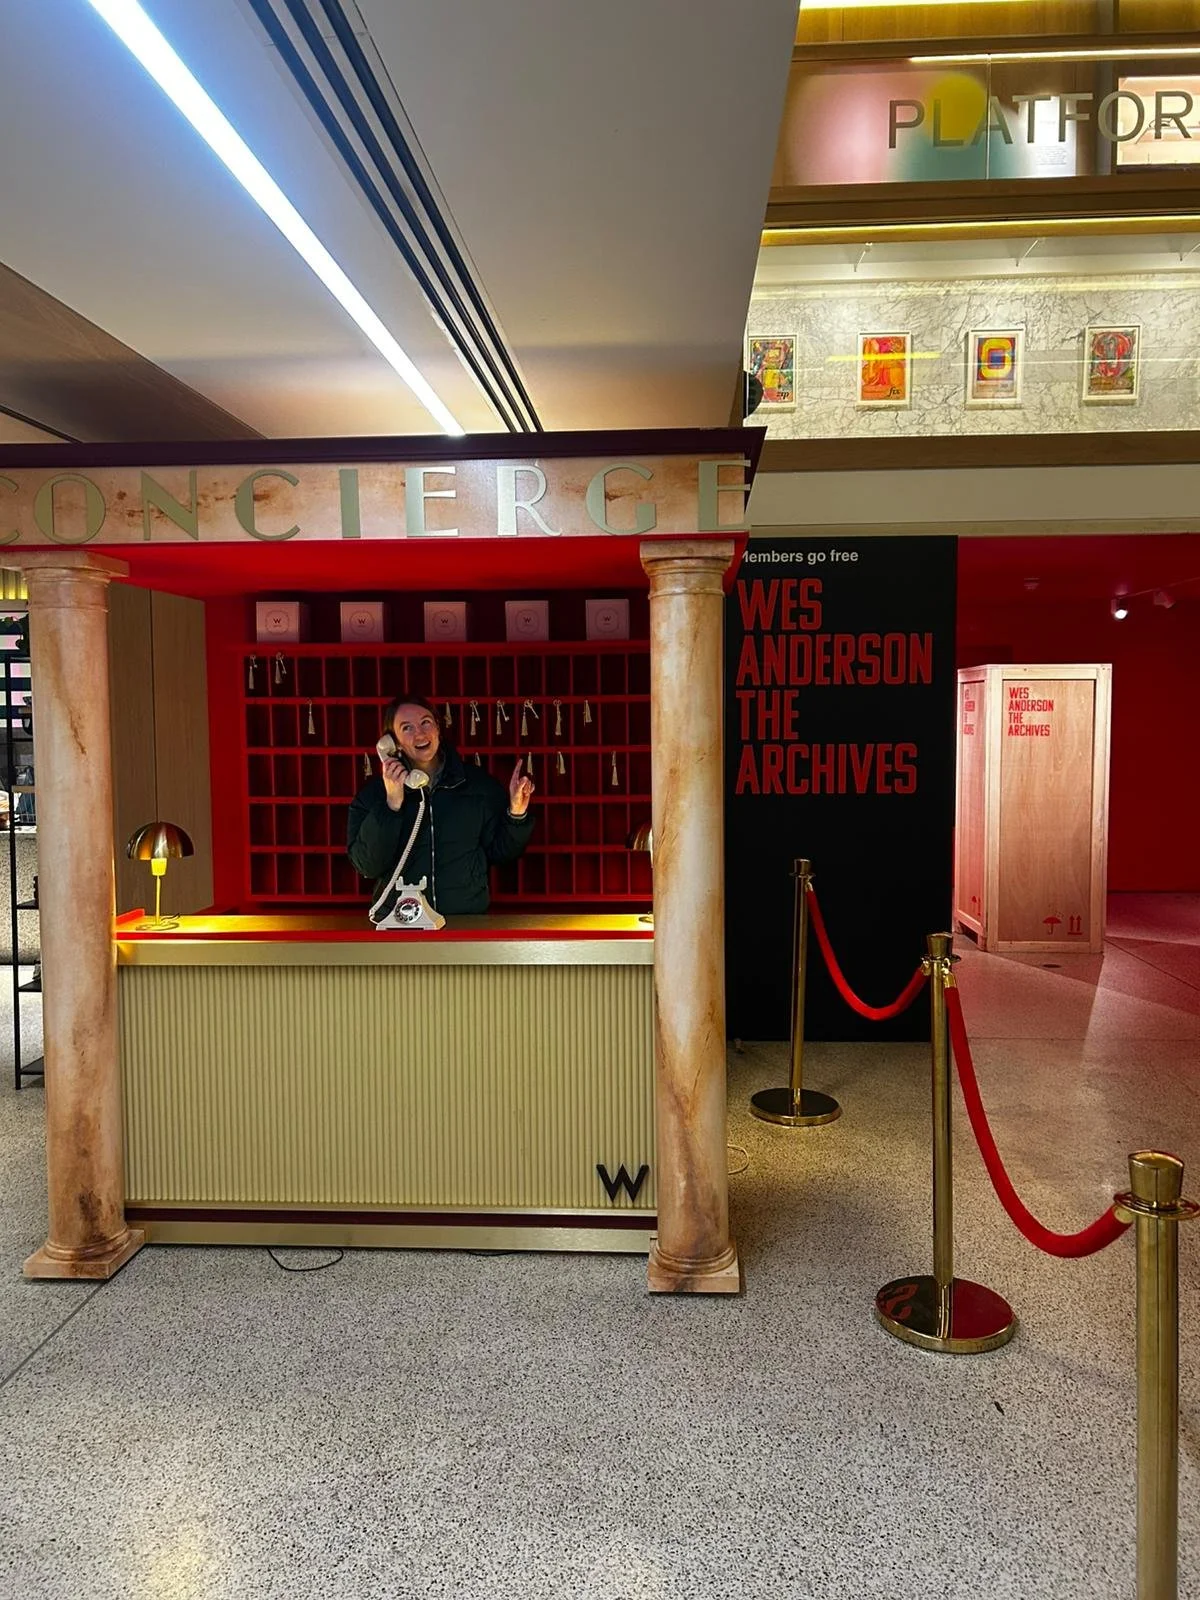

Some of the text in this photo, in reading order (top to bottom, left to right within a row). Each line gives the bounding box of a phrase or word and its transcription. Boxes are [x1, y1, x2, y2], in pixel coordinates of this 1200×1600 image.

[888, 90, 1193, 149] PLATFOR
[807, 552, 826, 565] go
[830, 549, 859, 562] free
[737, 578, 823, 630] WES
[736, 632, 933, 686] ANDERSON
[1008, 700, 1054, 711] ANDERSON
[1009, 687, 1029, 699] WES
[735, 689, 799, 740] THE
[1008, 712, 1023, 724] THE
[1008, 724, 1050, 737] ARCHIVES
[735, 743, 918, 795] ARCHIVES
[596, 1163, 650, 1203] W
